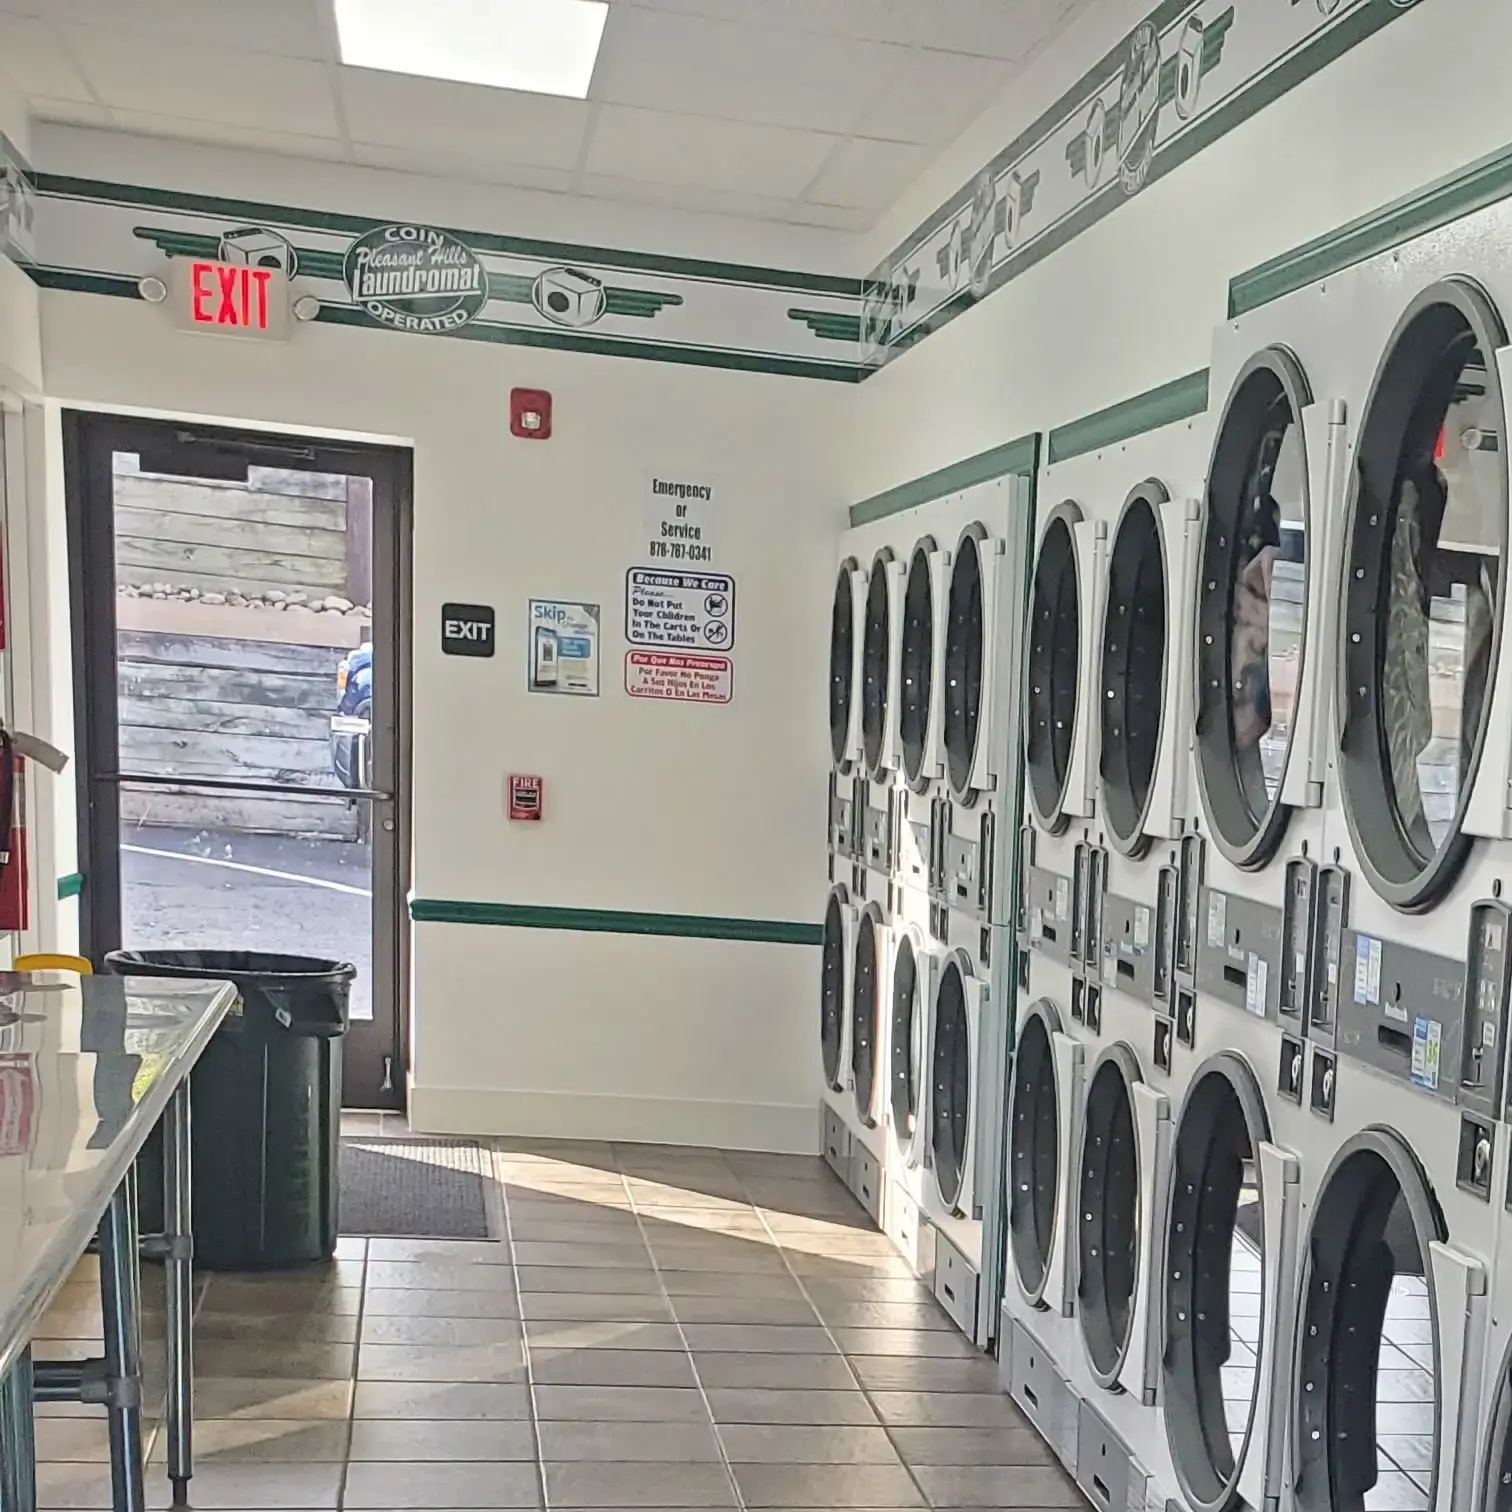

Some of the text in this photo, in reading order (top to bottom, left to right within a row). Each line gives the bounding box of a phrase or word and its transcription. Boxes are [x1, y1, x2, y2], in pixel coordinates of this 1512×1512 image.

[385, 226, 444, 246] COIN
[357, 243, 467, 269] Pleasant Hills
[353, 264, 480, 300] Laundromat
[192, 262, 271, 329] EXIT
[367, 301, 469, 331] OPERATED
[652, 478, 711, 500] Emergency
[676, 504, 687, 518] or
[661, 520, 701, 540] Service
[636, 573, 725, 590] Because We Care
[632, 597, 683, 610] Do Not Put
[534, 605, 566, 624] Skip
[633, 608, 695, 621] Your Children
[445, 619, 491, 641] EXIT
[632, 619, 701, 633] In The Carts Or
[632, 630, 695, 643] On The Tables
[638, 667, 719, 681] Por Favor No Ponga
[631, 685, 663, 695] Carritos
[675, 689, 685, 697] En
[687, 690, 700, 698] Las
[643, 677, 716, 690] A Sus Hijos En Los
[513, 777, 540, 789] FIRE
